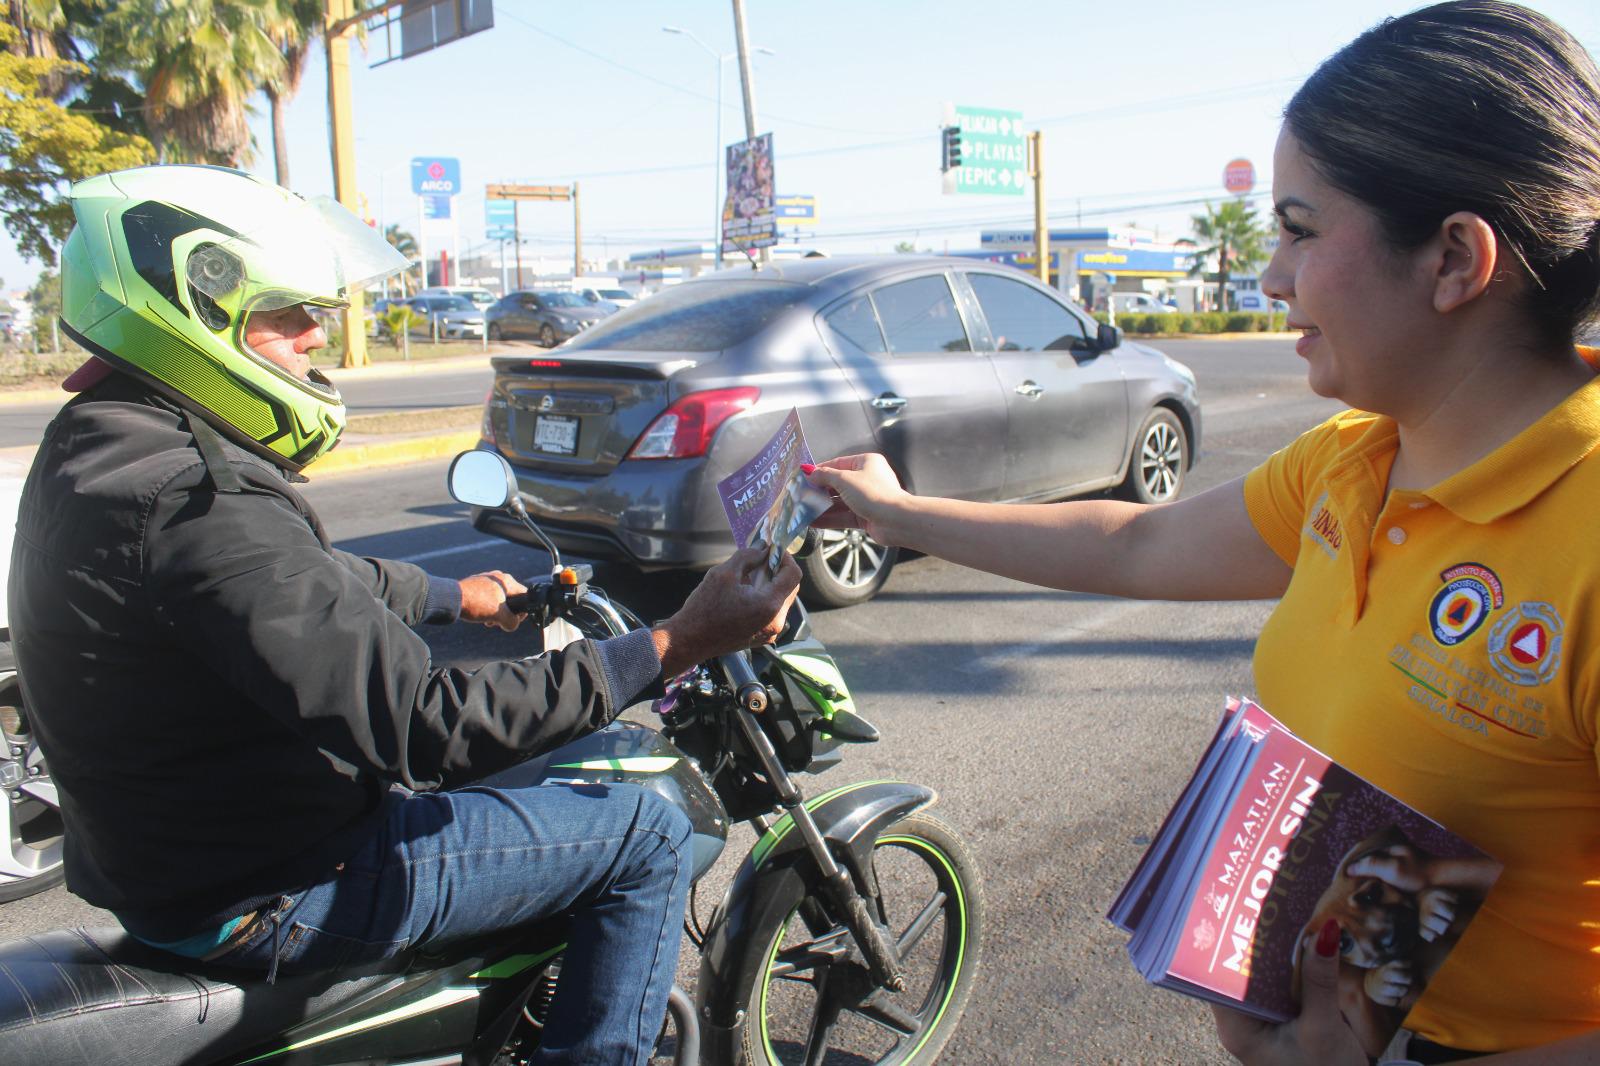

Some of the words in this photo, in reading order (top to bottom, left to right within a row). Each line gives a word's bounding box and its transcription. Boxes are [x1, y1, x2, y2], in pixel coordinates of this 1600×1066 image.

[957, 166, 997, 186] TEPIC
[975, 141, 1023, 162] PLAYAS
[420, 180, 453, 192] ARCO
[733, 462, 778, 508] MEJOR
[780, 432, 797, 460] SIN
[1407, 685, 1488, 736] SINALOA
[1217, 761, 1286, 885] MAZATLÁN
[1222, 845, 1287, 972] MEJOR
[1278, 775, 1324, 837] SIN
[1238, 790, 1342, 977] PIROTECNIA
